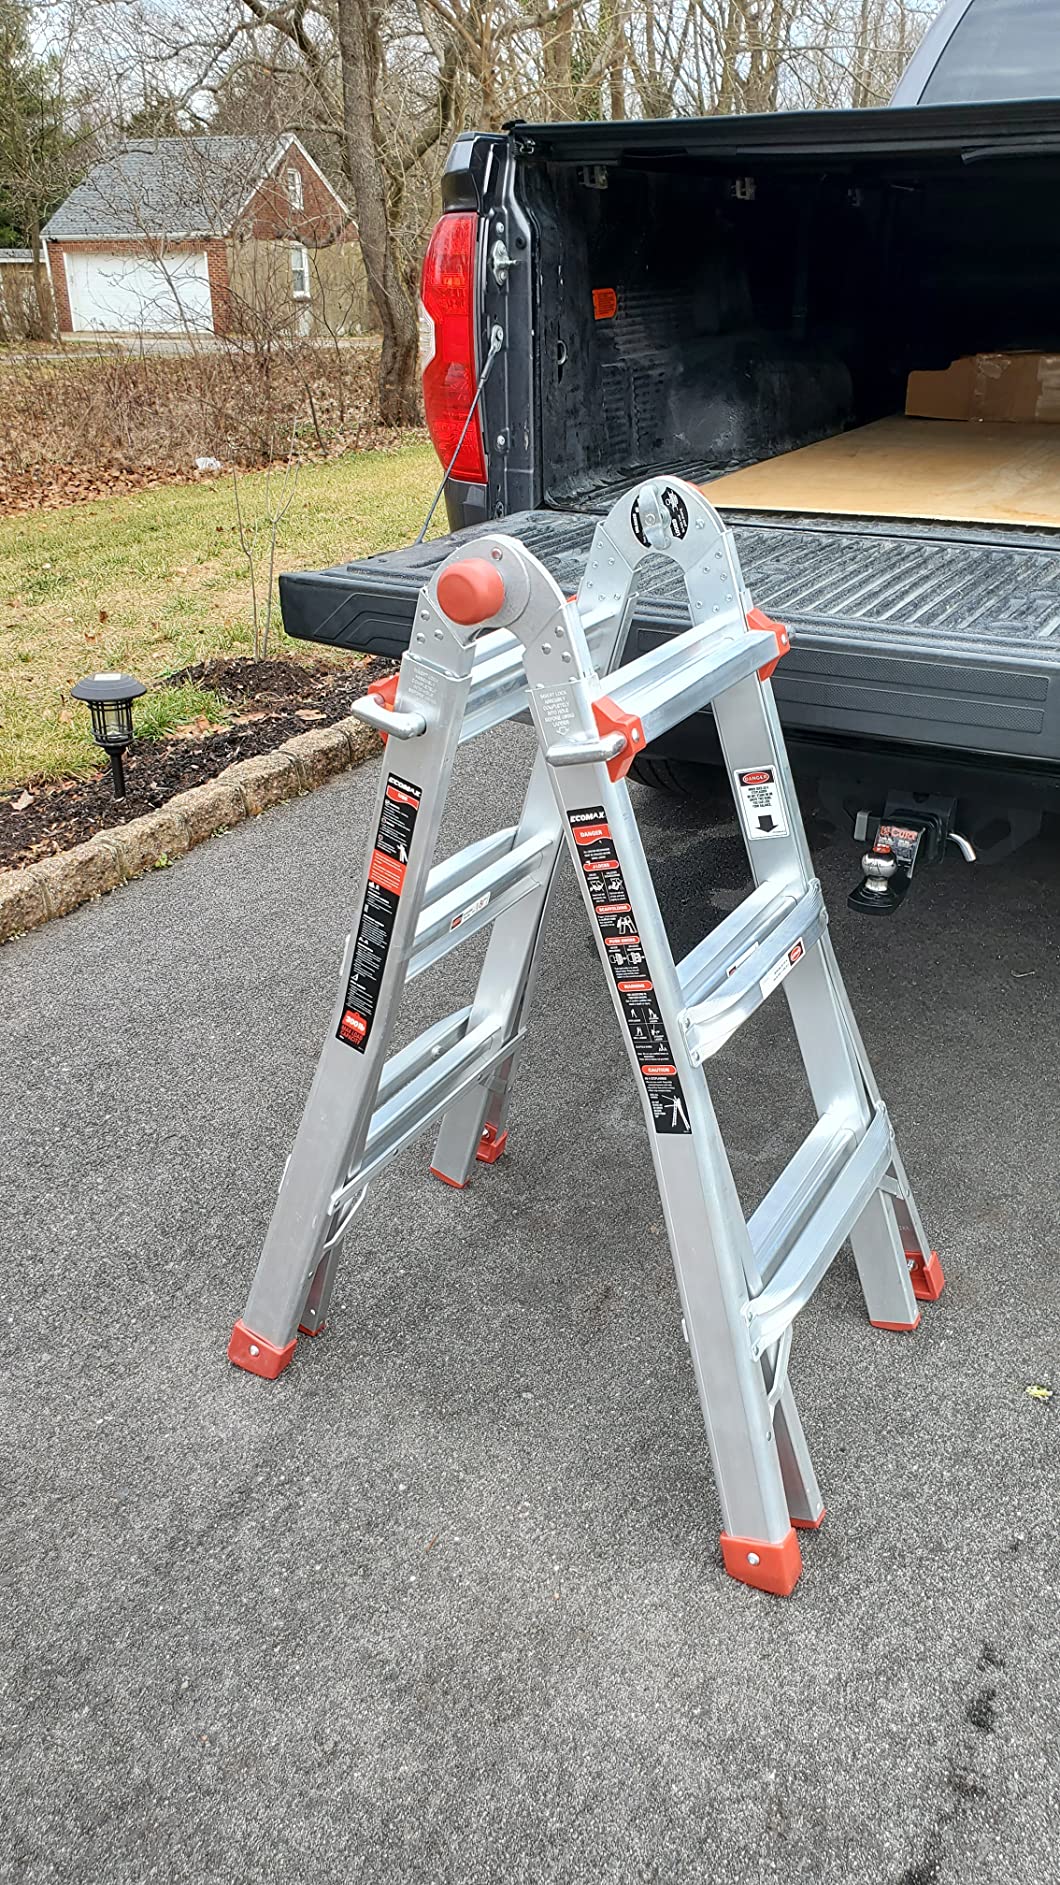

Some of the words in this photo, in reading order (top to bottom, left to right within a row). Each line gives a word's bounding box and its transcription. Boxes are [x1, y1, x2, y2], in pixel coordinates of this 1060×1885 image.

[388, 776, 421, 797] ECOMAX
[570, 811, 605, 823] ECOMAX
[580, 829, 603, 838] DANGER
